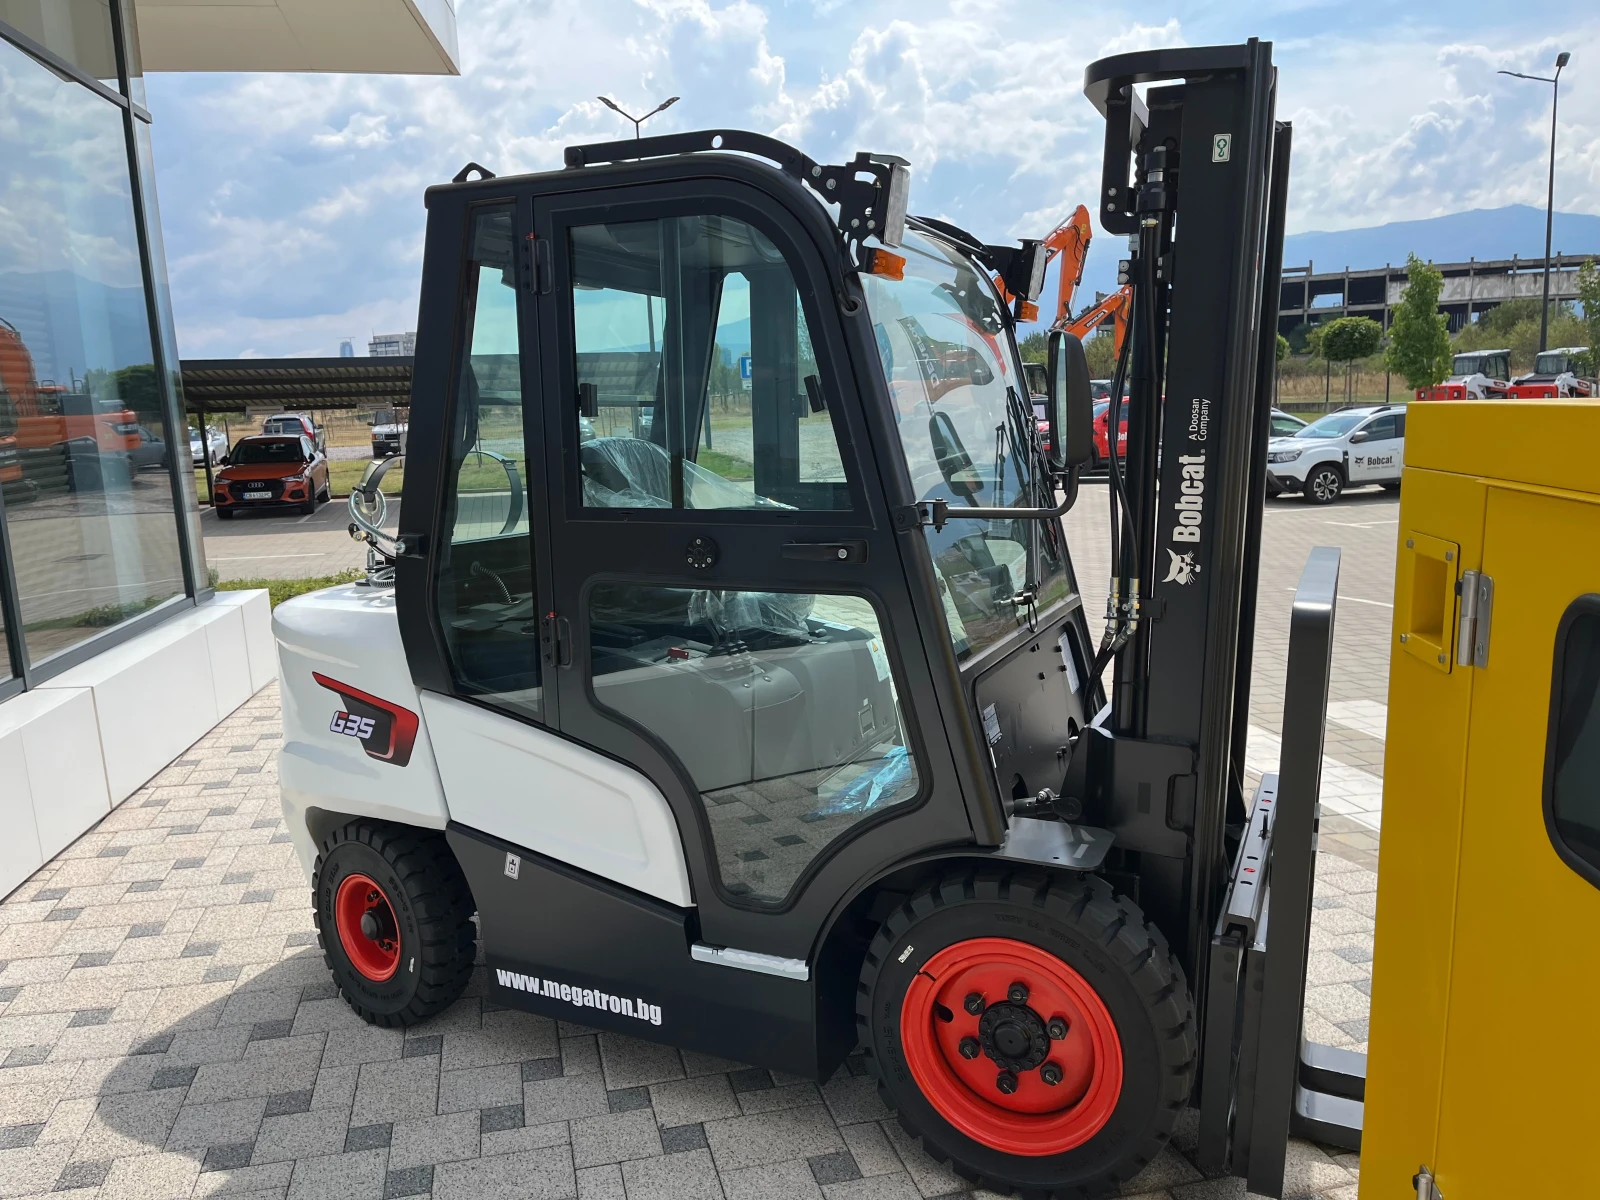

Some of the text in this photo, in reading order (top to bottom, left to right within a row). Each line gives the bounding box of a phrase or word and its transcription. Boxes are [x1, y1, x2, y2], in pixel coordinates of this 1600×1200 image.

[1188, 398, 1200, 441] A Doosan
[1198, 398, 1211, 441] Company
[1367, 456, 1393, 466] Bobcat
[1172, 455, 1206, 543] Bobcat
[330, 710, 376, 739] G35
[495, 968, 662, 1026] www.megatron.bg
